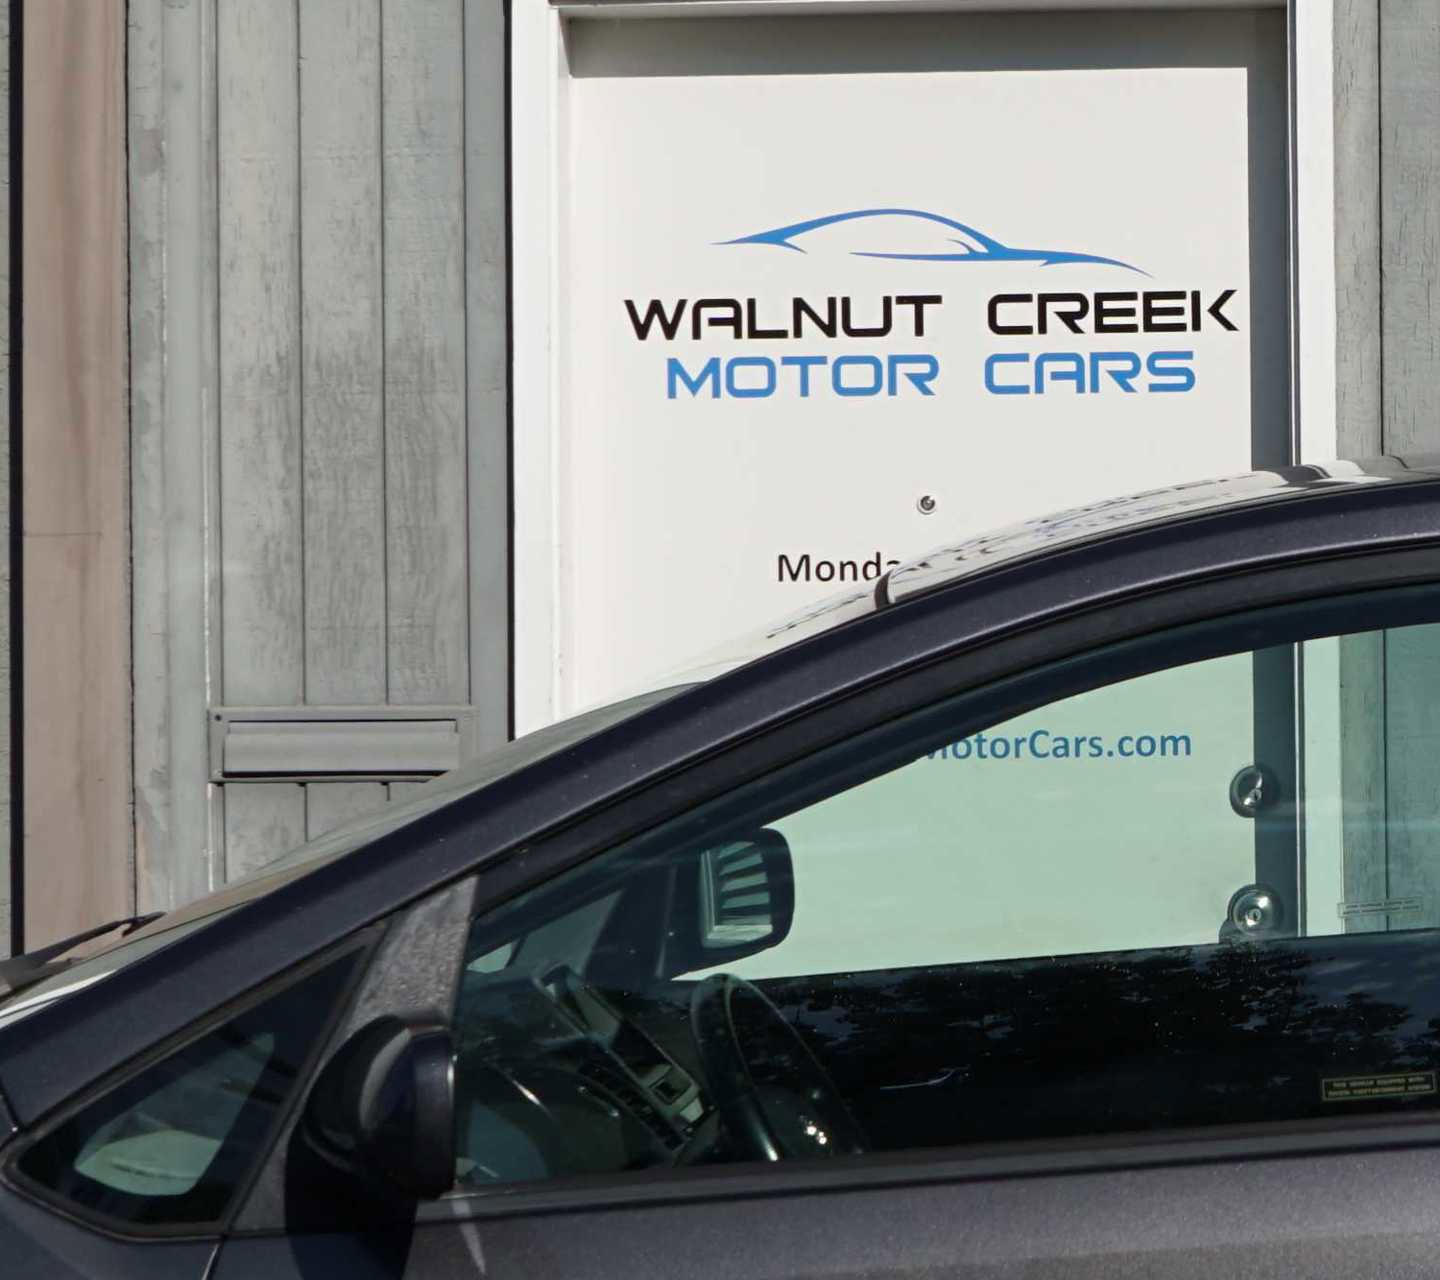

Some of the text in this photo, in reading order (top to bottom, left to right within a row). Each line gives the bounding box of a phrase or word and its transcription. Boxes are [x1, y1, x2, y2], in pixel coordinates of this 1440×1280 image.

[624, 289, 1239, 341] WALNUT CREEK
[666, 350, 1196, 400] MOTOR CARS
